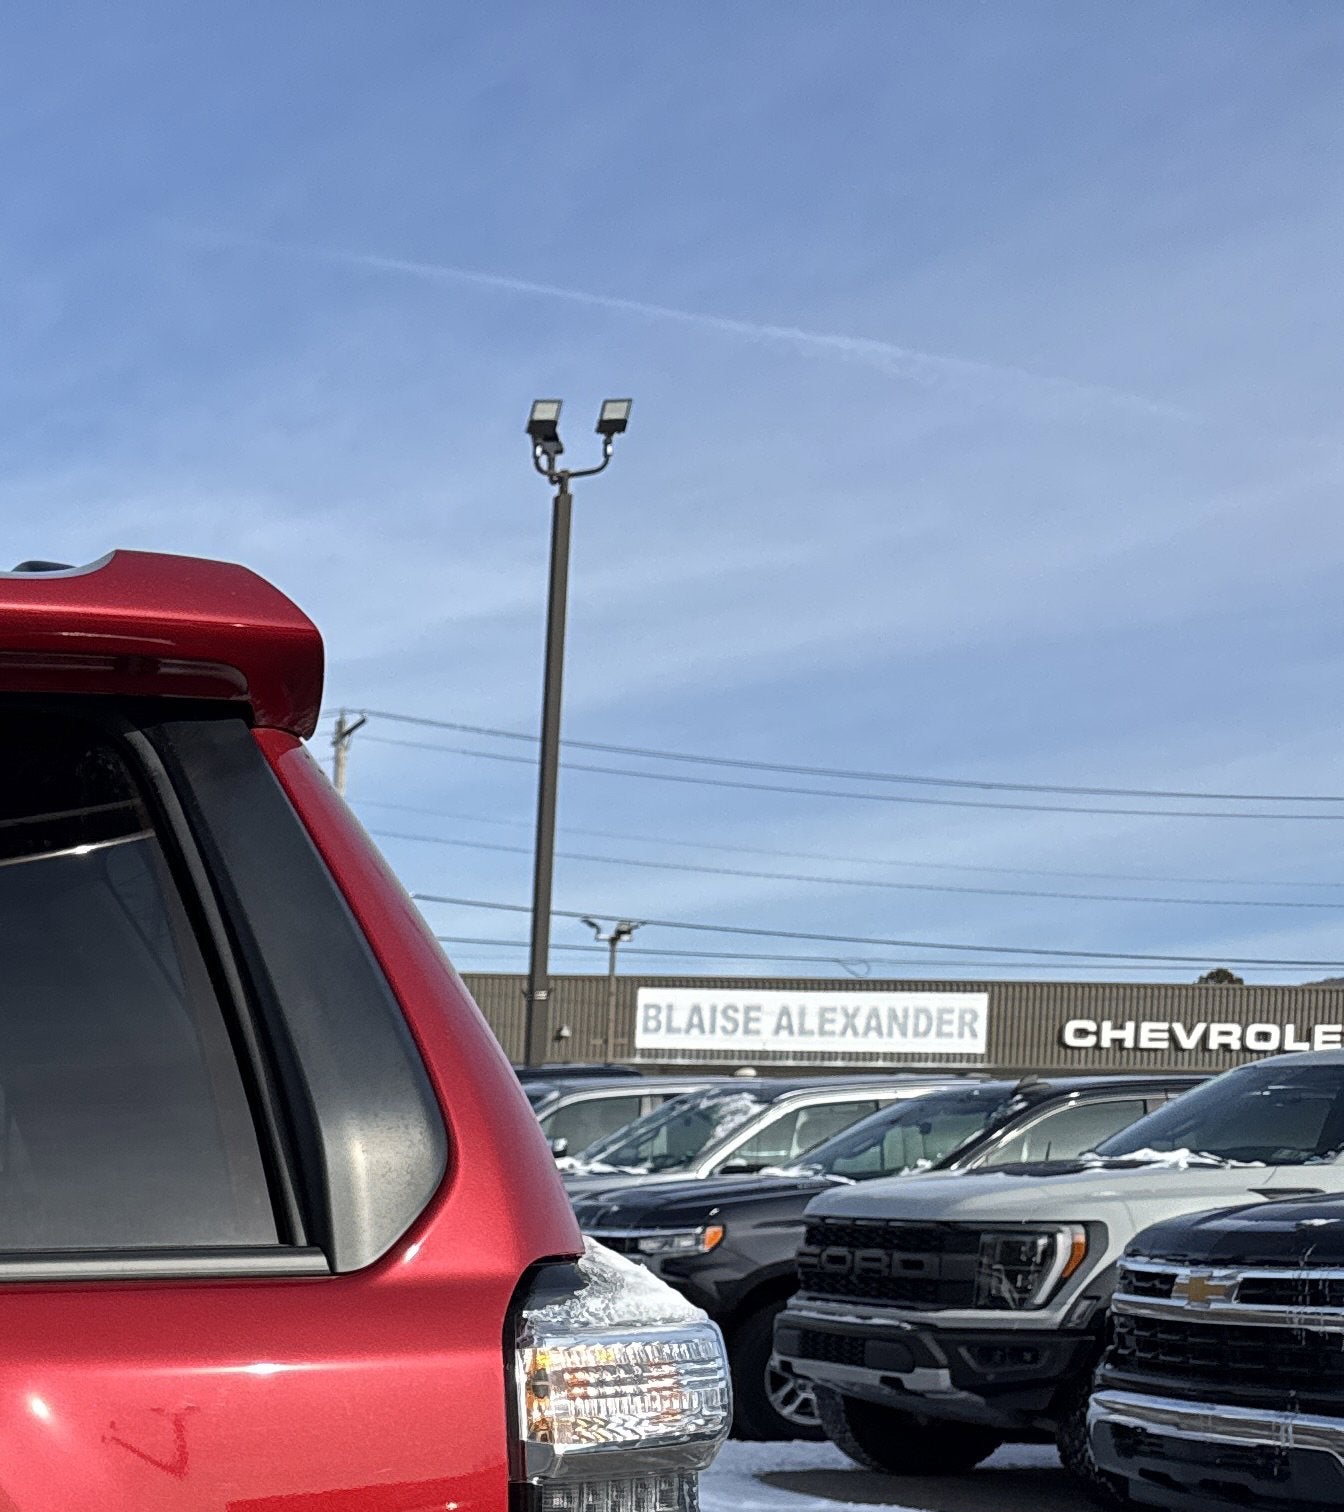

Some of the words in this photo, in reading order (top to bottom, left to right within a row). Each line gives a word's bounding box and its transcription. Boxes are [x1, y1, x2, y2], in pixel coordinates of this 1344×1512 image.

[641, 1003, 762, 1036] BLAISE
[772, 1005, 979, 1039] ALEXANDER
[1063, 1019, 1344, 1052] CHEVROLE
